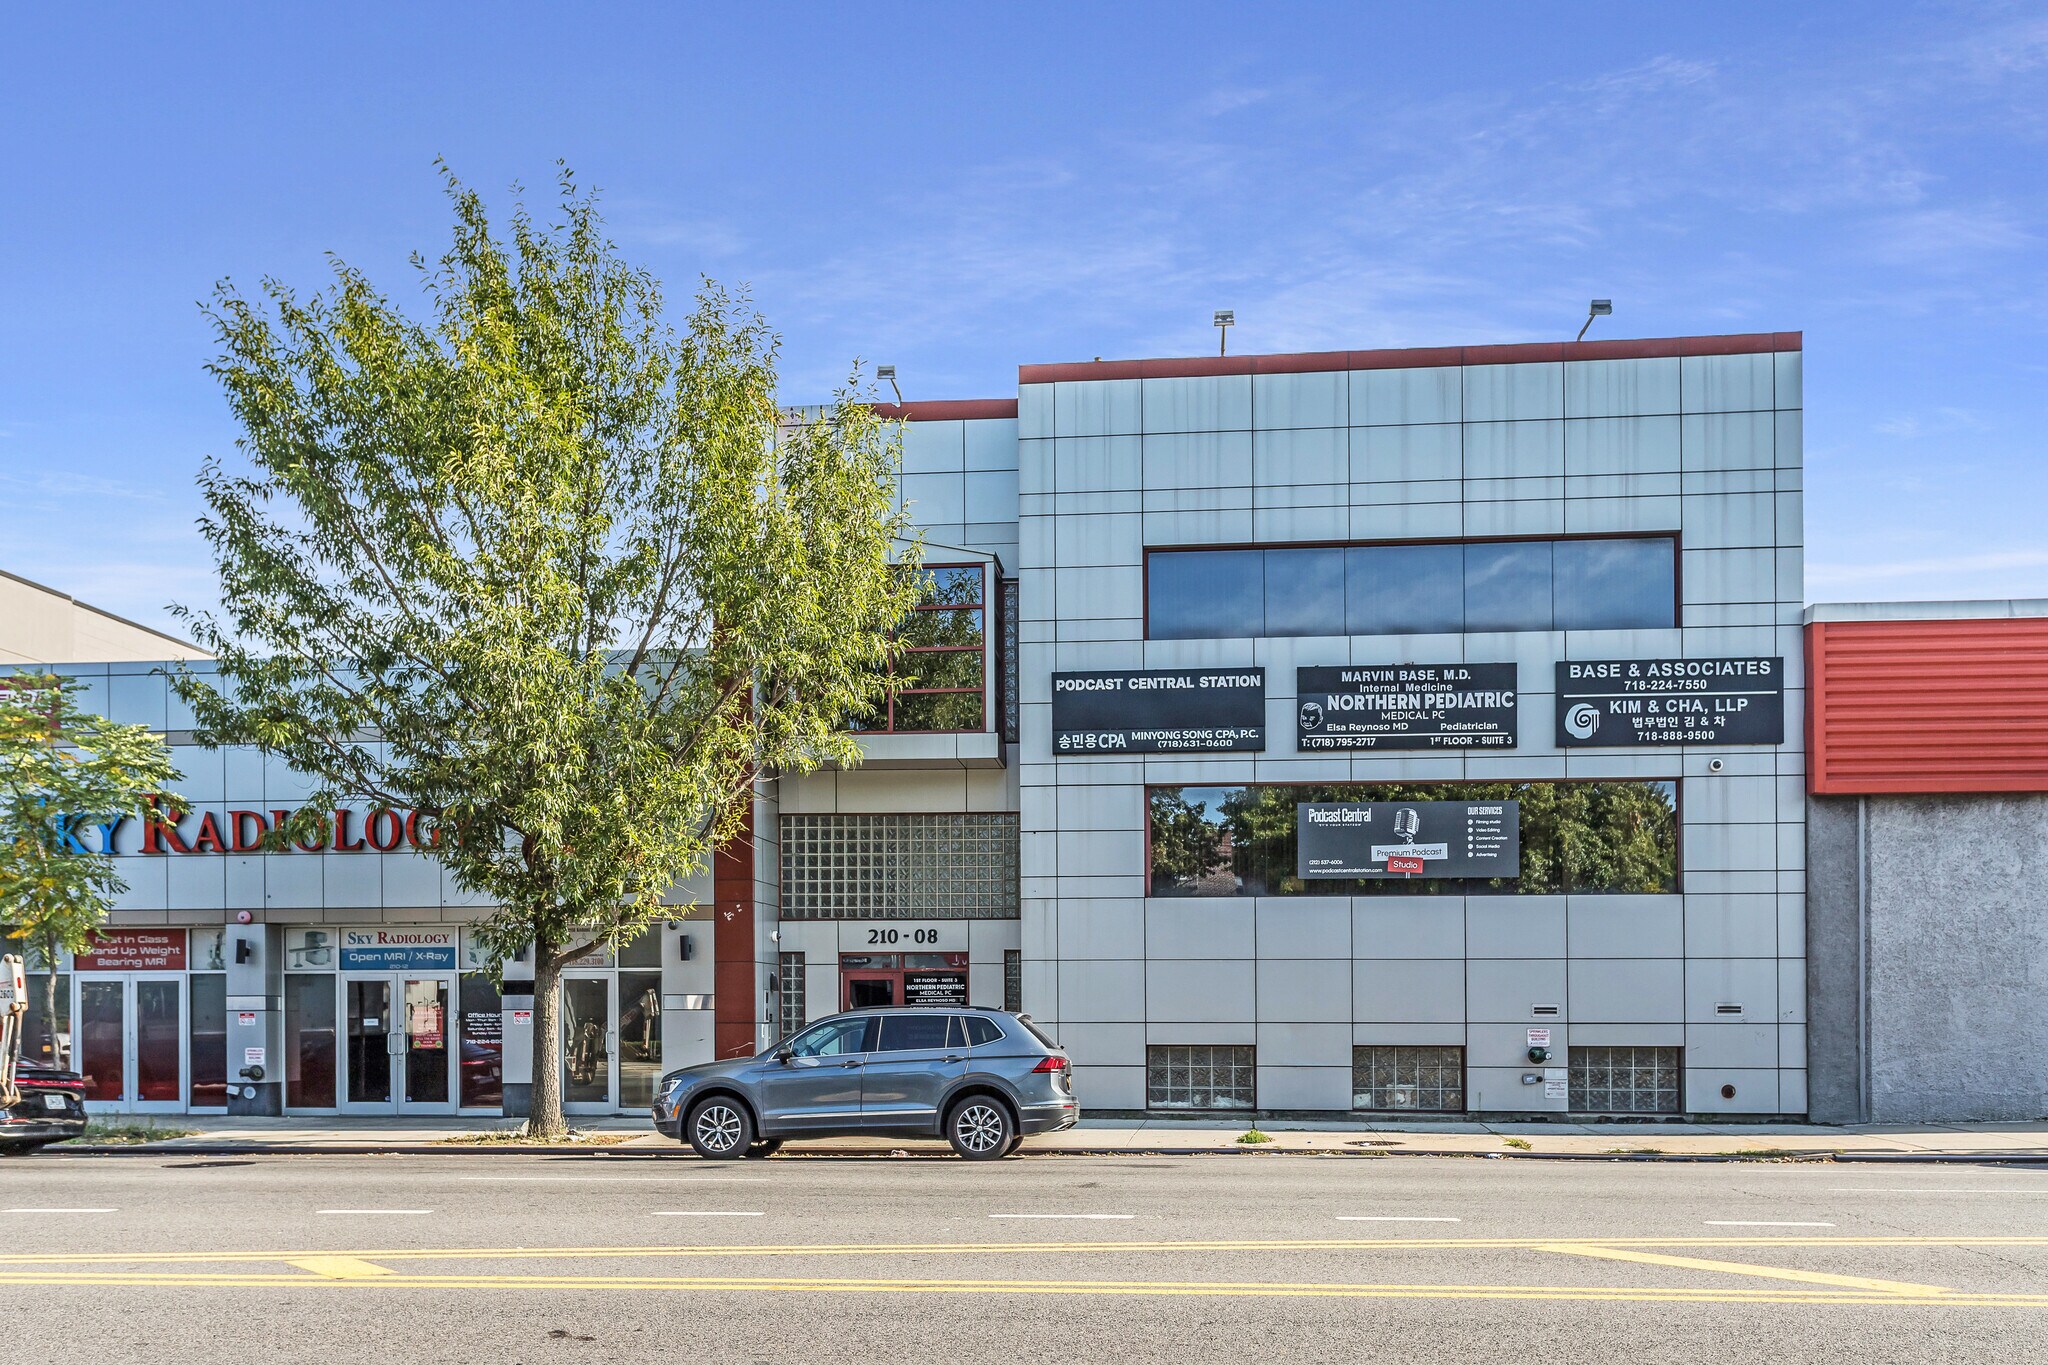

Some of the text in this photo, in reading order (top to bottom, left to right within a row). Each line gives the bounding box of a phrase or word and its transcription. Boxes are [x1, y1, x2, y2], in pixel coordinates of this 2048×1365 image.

[1570, 661, 1771, 678] BASE & ASSOCIATES
[1342, 670, 1471, 682] MARVIN BASE, M.D.
[1056, 675, 1260, 691] PODCAST CENTRAL STATION
[1360, 683, 1453, 693] Internal Medicine
[1624, 680, 1707, 690] 718-224-7550
[1327, 692, 1514, 710] NORTHERN PEDIATRIC
[1610, 699, 1748, 714] KIM & CHA, LLP
[1381, 711, 1445, 720] MEDICAL PC
[1440, 722, 1498, 731] Pediatrician
[1632, 716, 1726, 728] 법무법인 김 & 차
[1349, 723, 1390, 733] Reynoso
[1131, 730, 1259, 740] MINYONG SONG CPA, P.C.
[1481, 736, 1504, 744] SUITE
[1637, 731, 1714, 741] 718-888-9500
[1158, 739, 1233, 748] (718)631-0600
[1302, 738, 1376, 747] T: (718) 795-2717
[1308, 808, 1371, 822] Podcast Central
[1468, 806, 1503, 815] OUR SERVICES
[138, 793, 472, 854] RADIOLOG
[1393, 860, 1418, 869] Studio
[121, 947, 137, 956] Up
[140, 946, 180, 956] Weight
[97, 958, 142, 967] Bearing
[350, 953, 381, 962] Open
[416, 953, 449, 962] X-Ray
